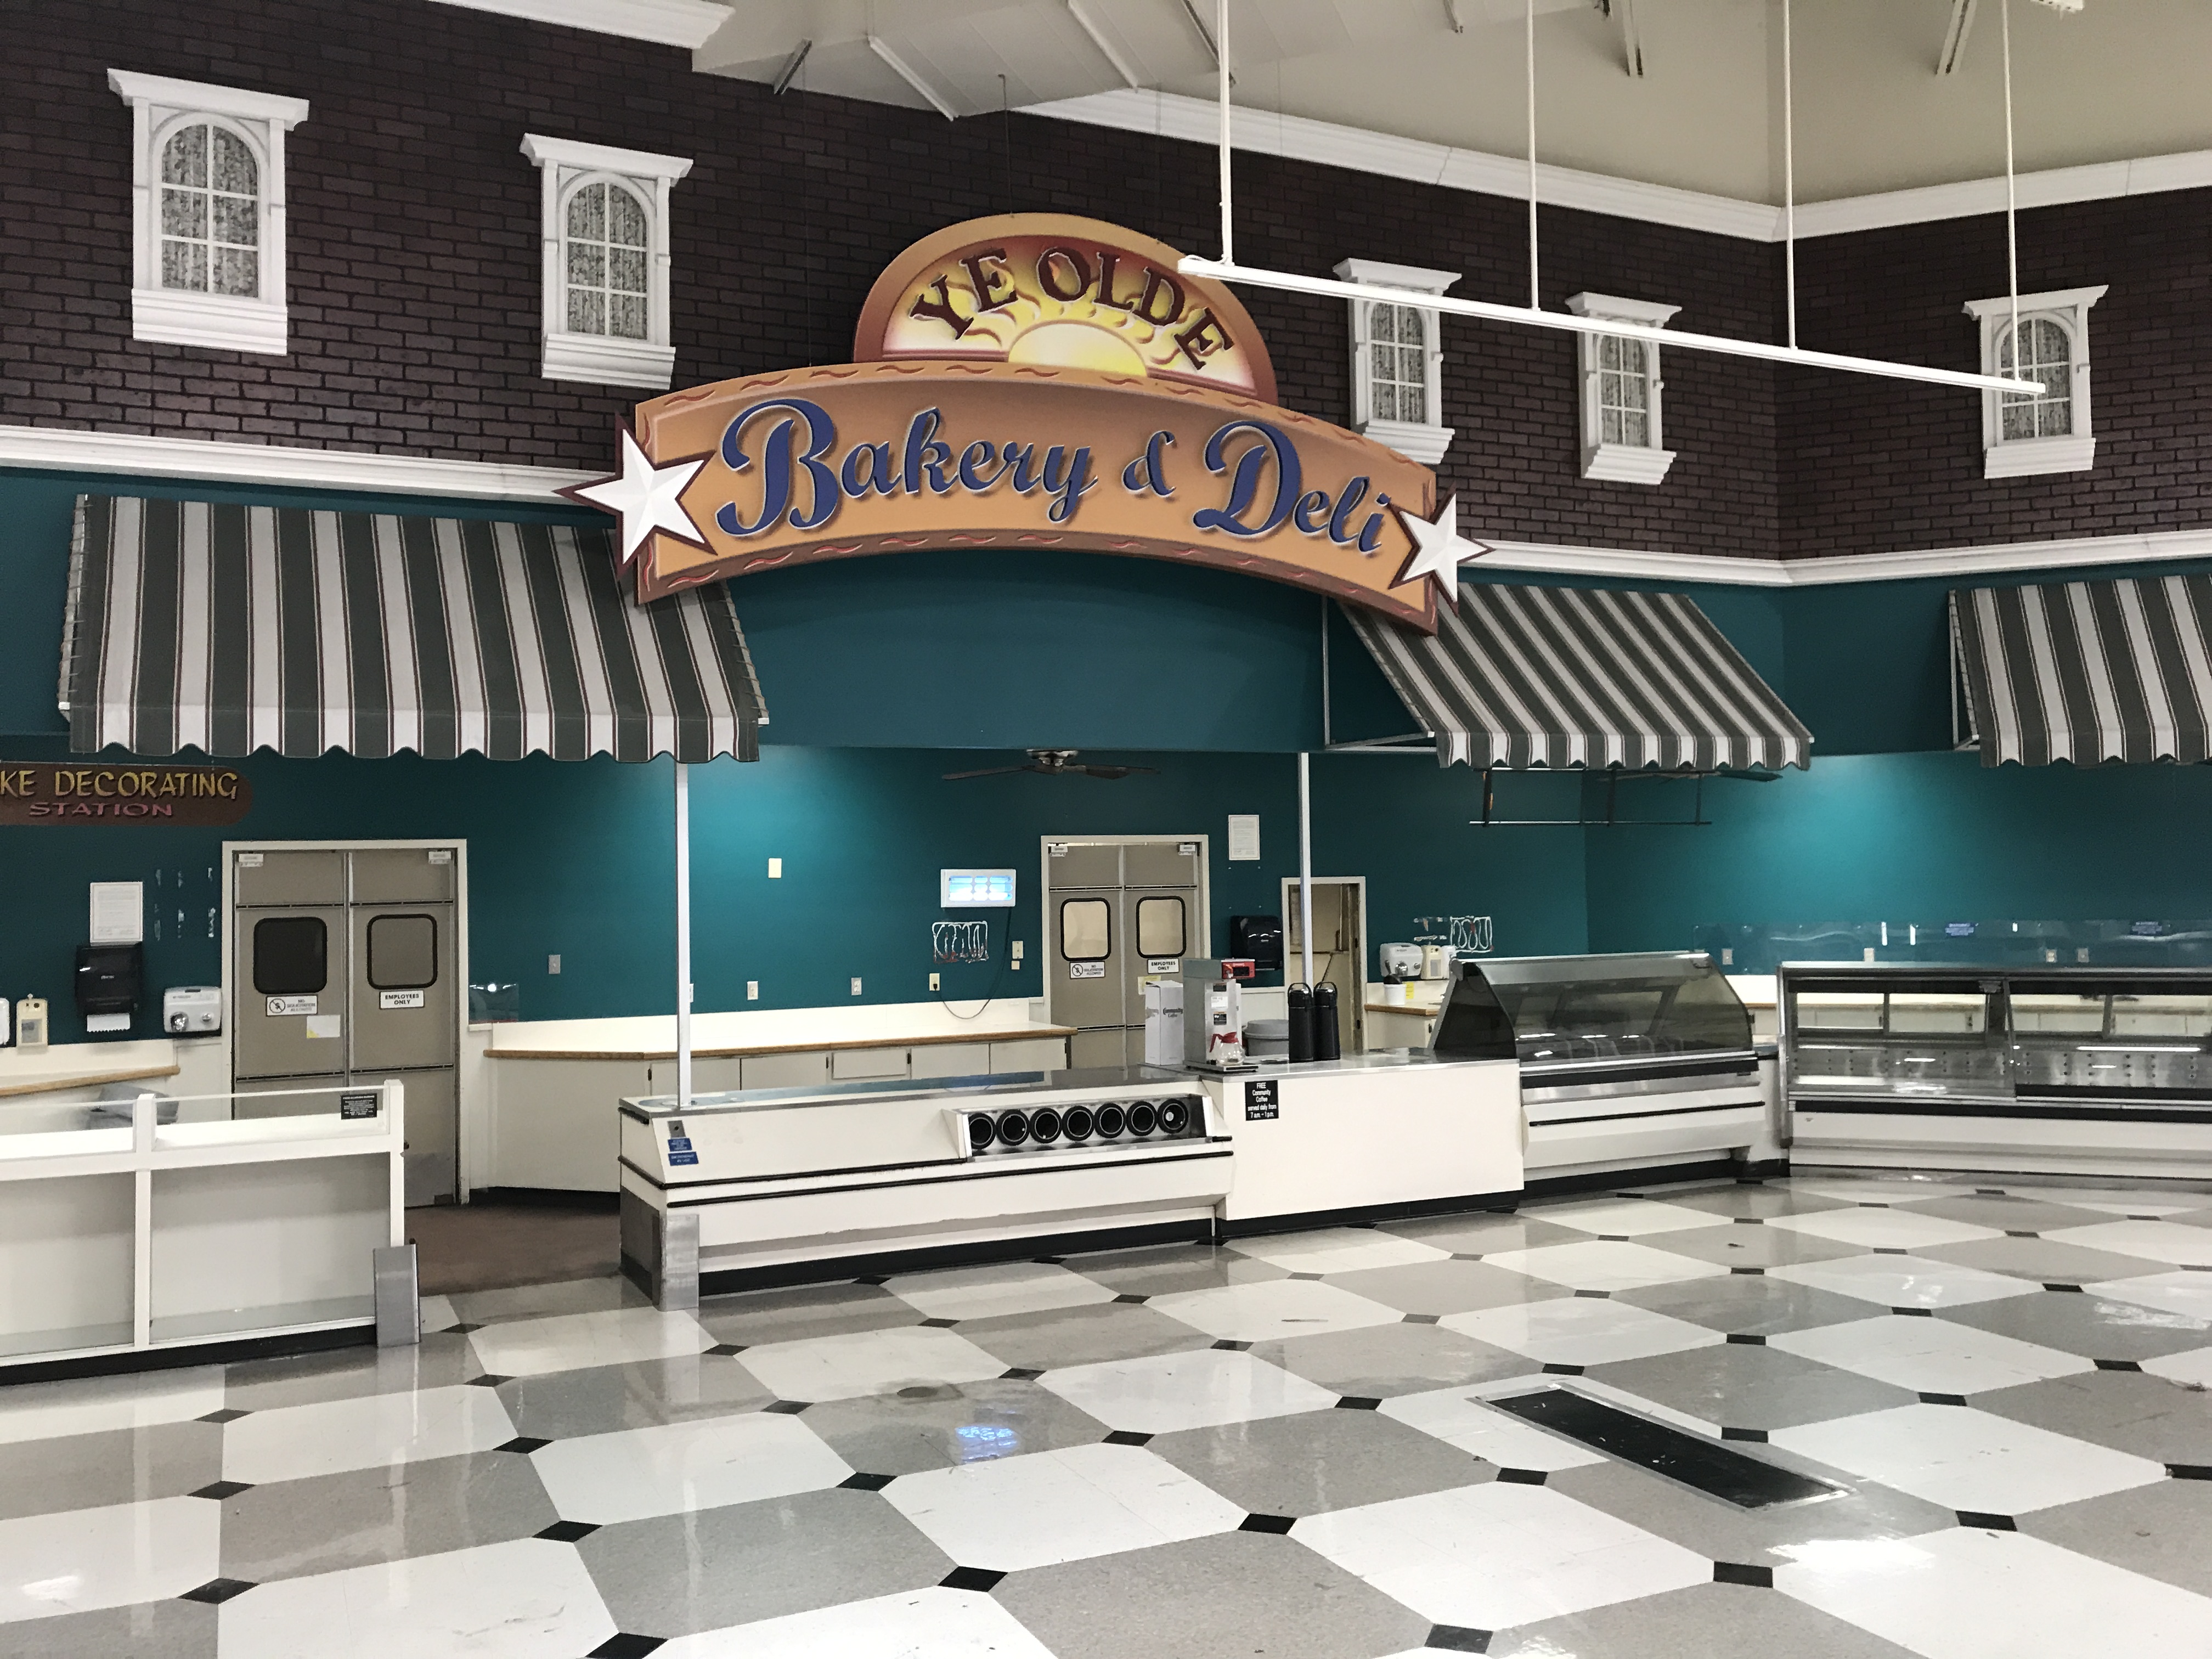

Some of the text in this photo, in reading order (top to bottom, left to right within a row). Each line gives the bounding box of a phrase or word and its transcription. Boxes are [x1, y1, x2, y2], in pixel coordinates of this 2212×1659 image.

[910, 246, 1235, 371] YE OLDE
[715, 396, 1392, 555] Bakery & Deli
[29, 802, 172, 816] STATION
[55, 770, 238, 799] DECORATING
